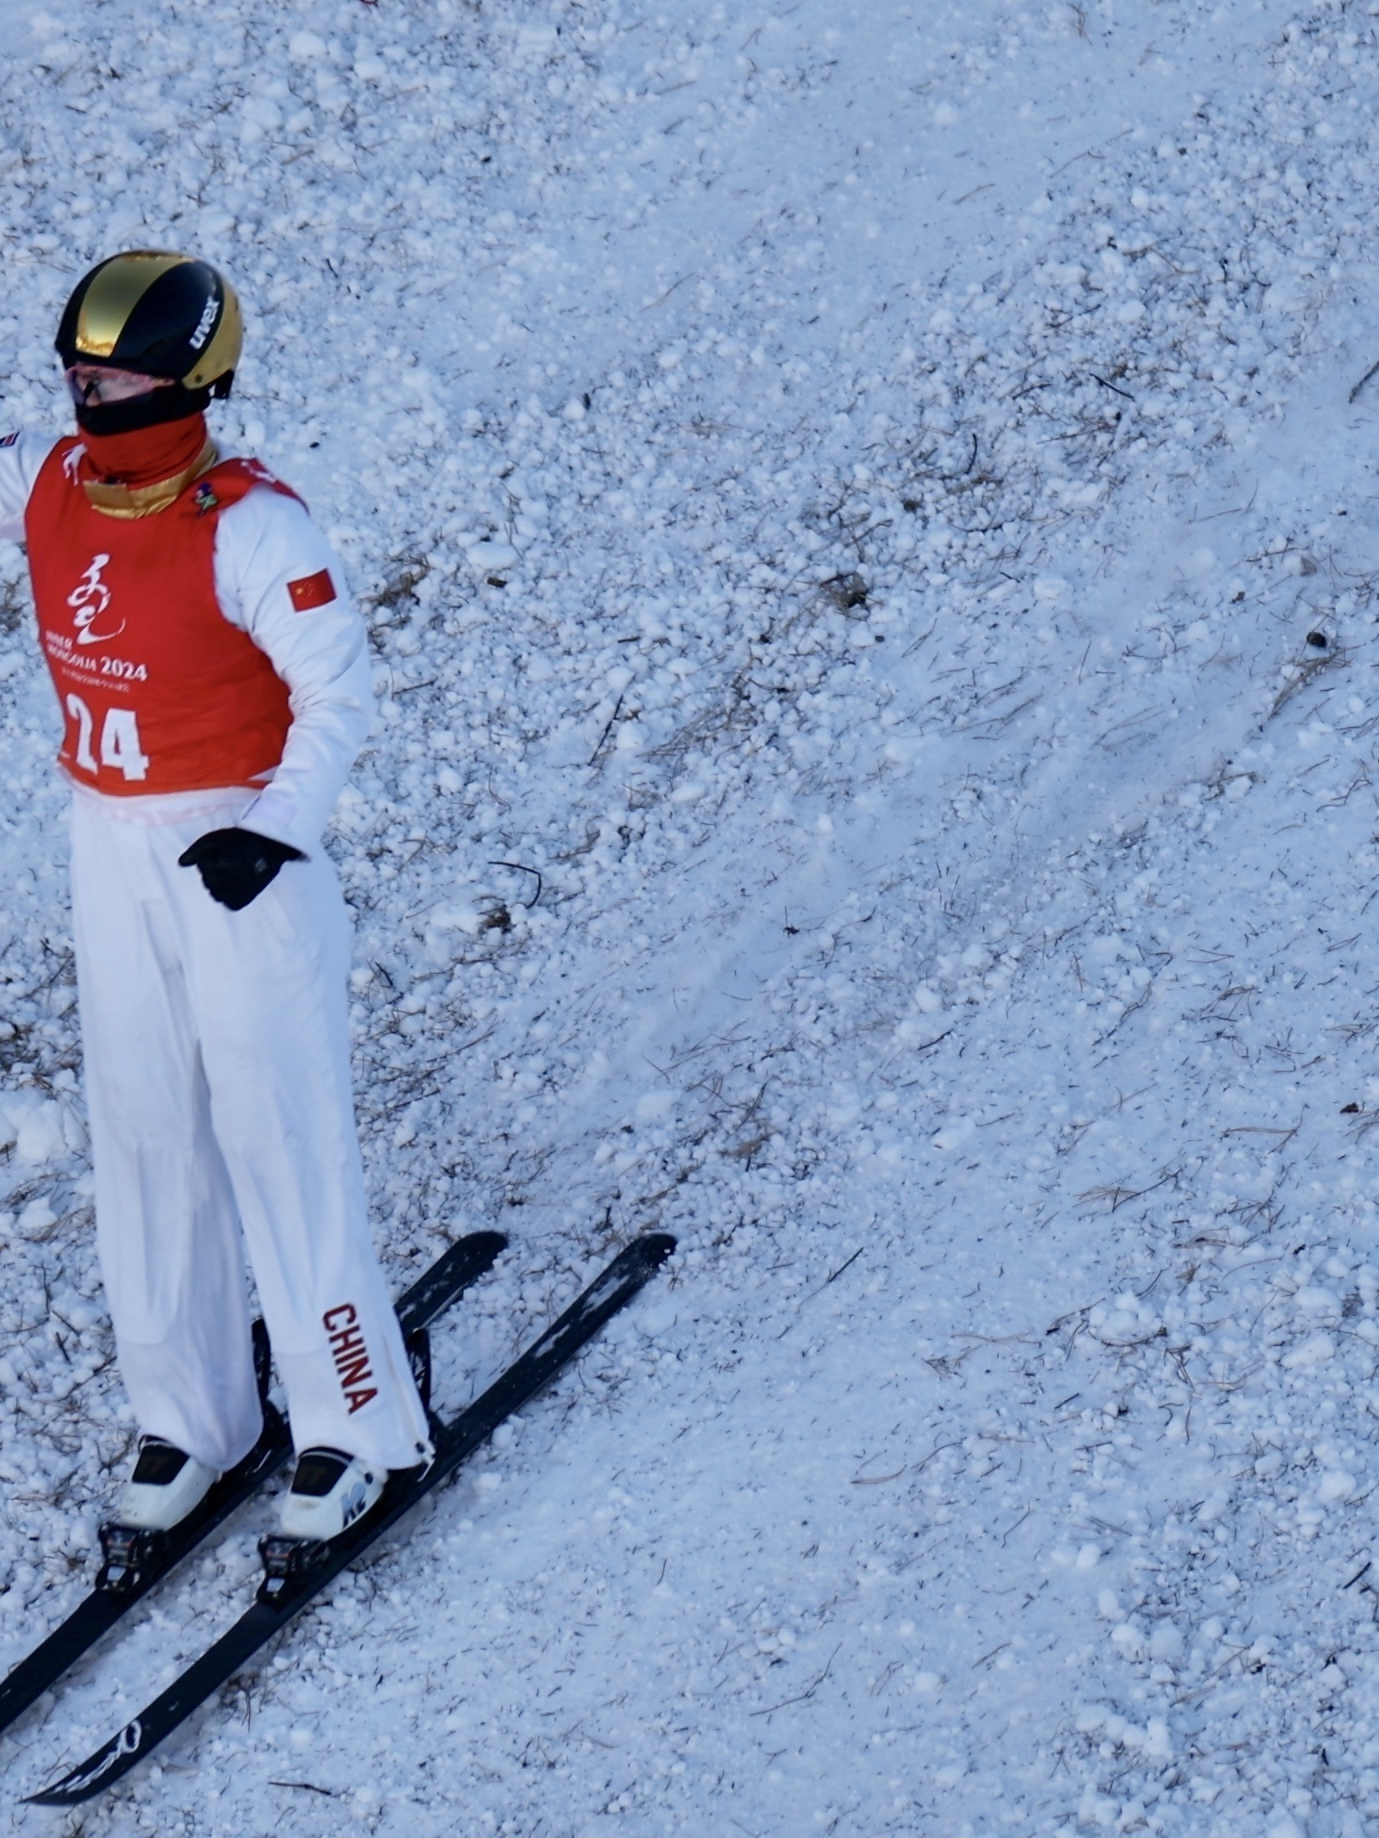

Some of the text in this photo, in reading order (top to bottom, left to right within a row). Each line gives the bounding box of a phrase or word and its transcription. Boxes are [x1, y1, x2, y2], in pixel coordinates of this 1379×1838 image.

[189, 295, 220, 350] uvex
[99, 655, 148, 682] 2024
[322, 1302, 378, 1415] CHINA
